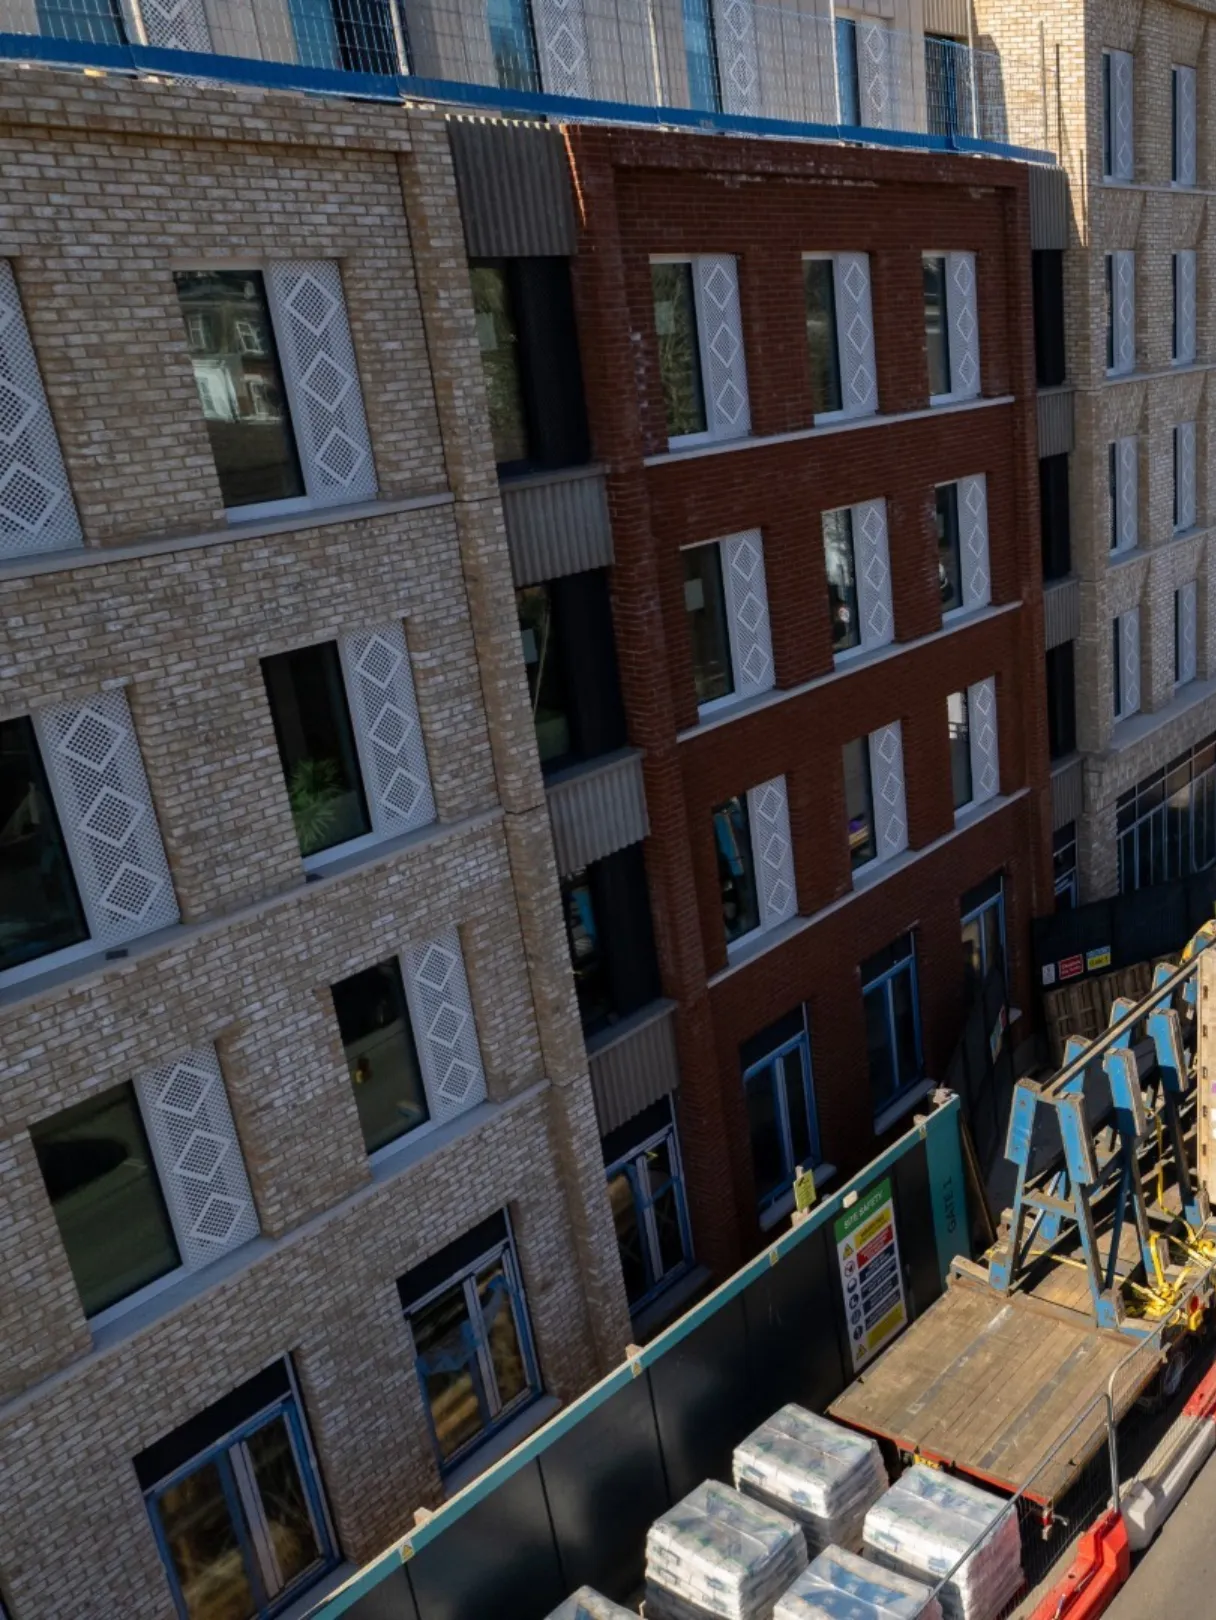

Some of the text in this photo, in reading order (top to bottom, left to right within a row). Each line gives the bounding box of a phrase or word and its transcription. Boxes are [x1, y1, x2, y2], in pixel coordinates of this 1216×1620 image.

[843, 1211, 860, 1230] SITE
[860, 1190, 883, 1217] SAFETY
[943, 1190, 957, 1234] GATE
